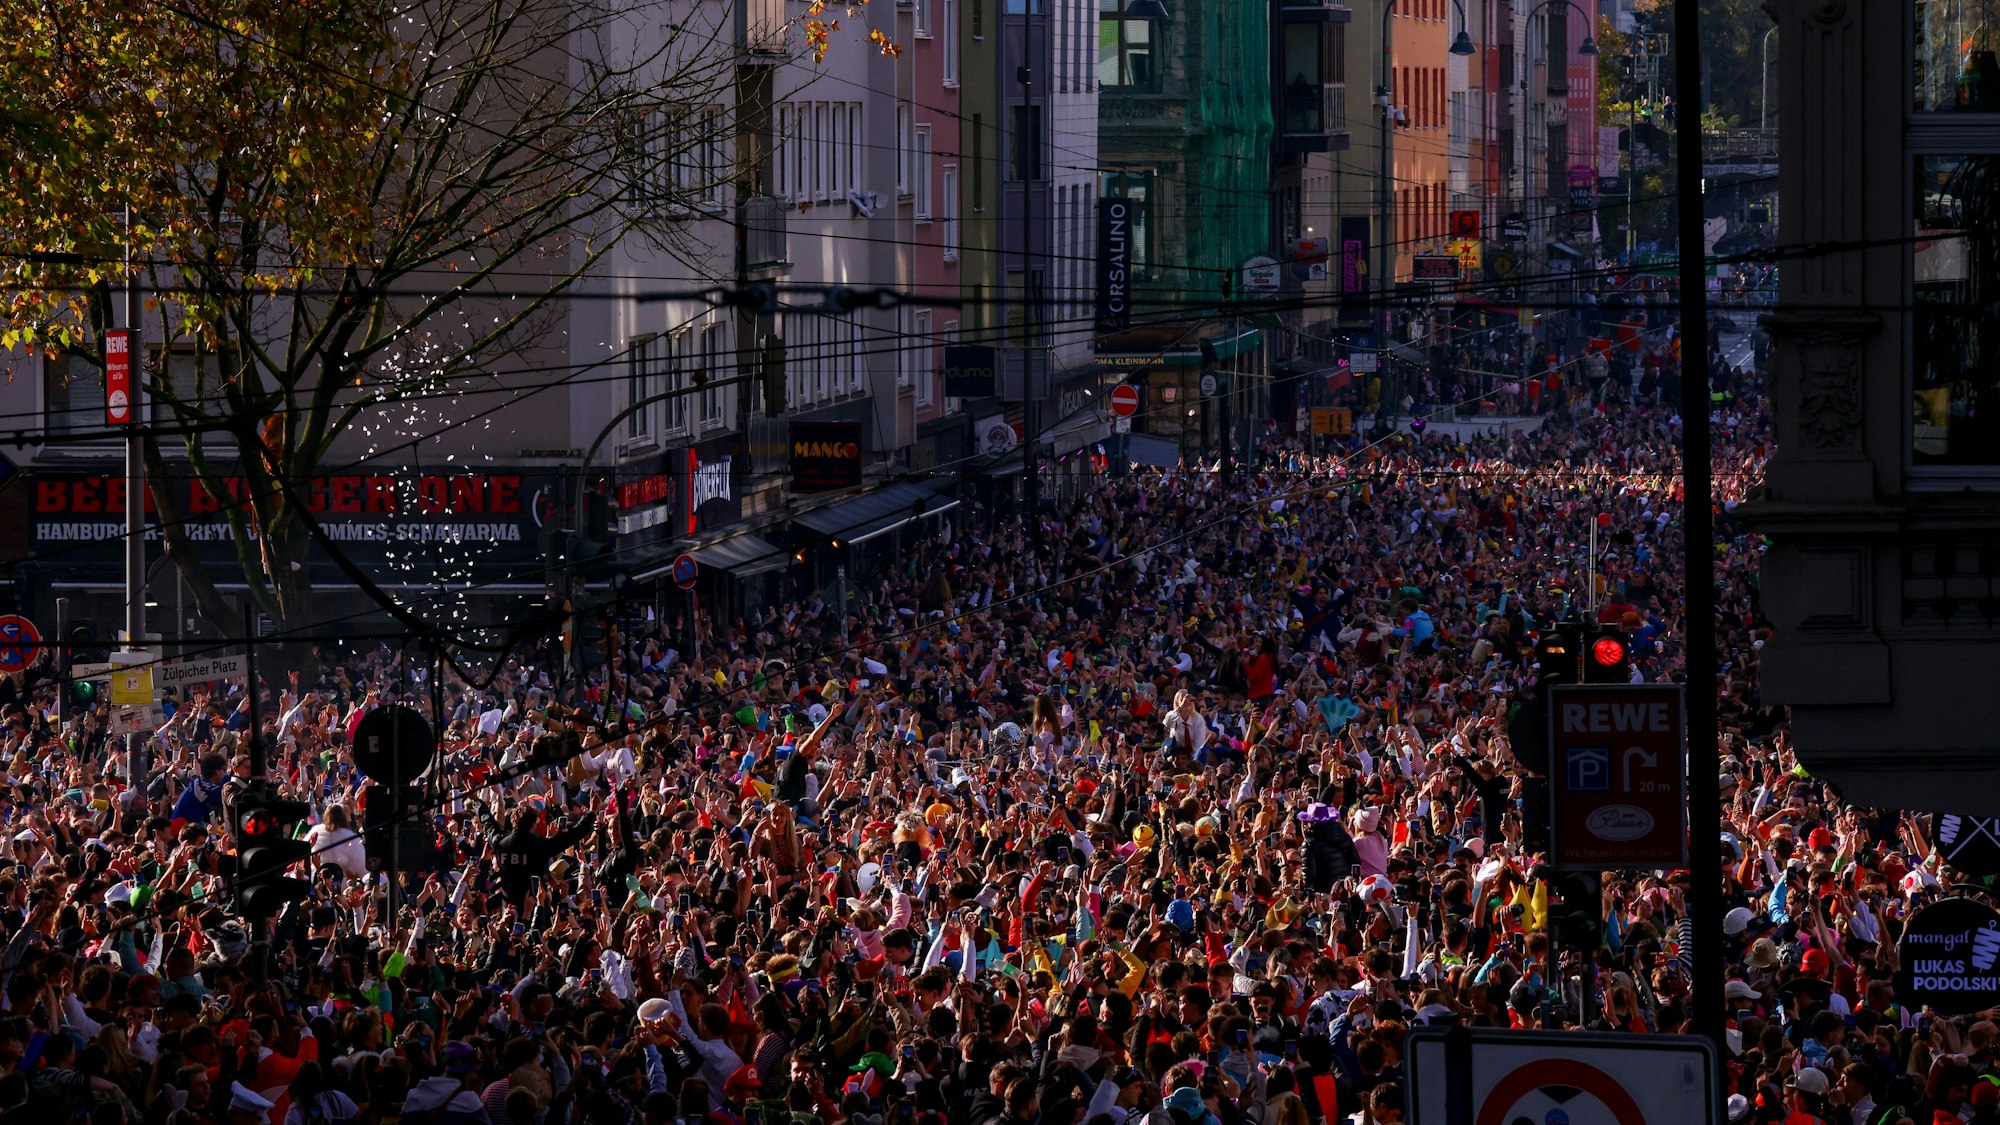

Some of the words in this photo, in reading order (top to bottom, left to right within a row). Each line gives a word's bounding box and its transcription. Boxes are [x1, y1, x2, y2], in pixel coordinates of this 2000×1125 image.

[105, 336, 128, 354] REWE
[946, 365, 993, 378] duma
[418, 475, 523, 513] ONE
[162, 664, 209, 682] Zülpicher
[212, 659, 238, 675] Platz
[1562, 703, 1671, 733] REWE
[1639, 781, 1655, 793] 20
[1658, 783, 1671, 792] m
[500, 852, 528, 865] FBI
[1908, 929, 1971, 951] mangal
[1913, 959, 1966, 974] LUKAS
